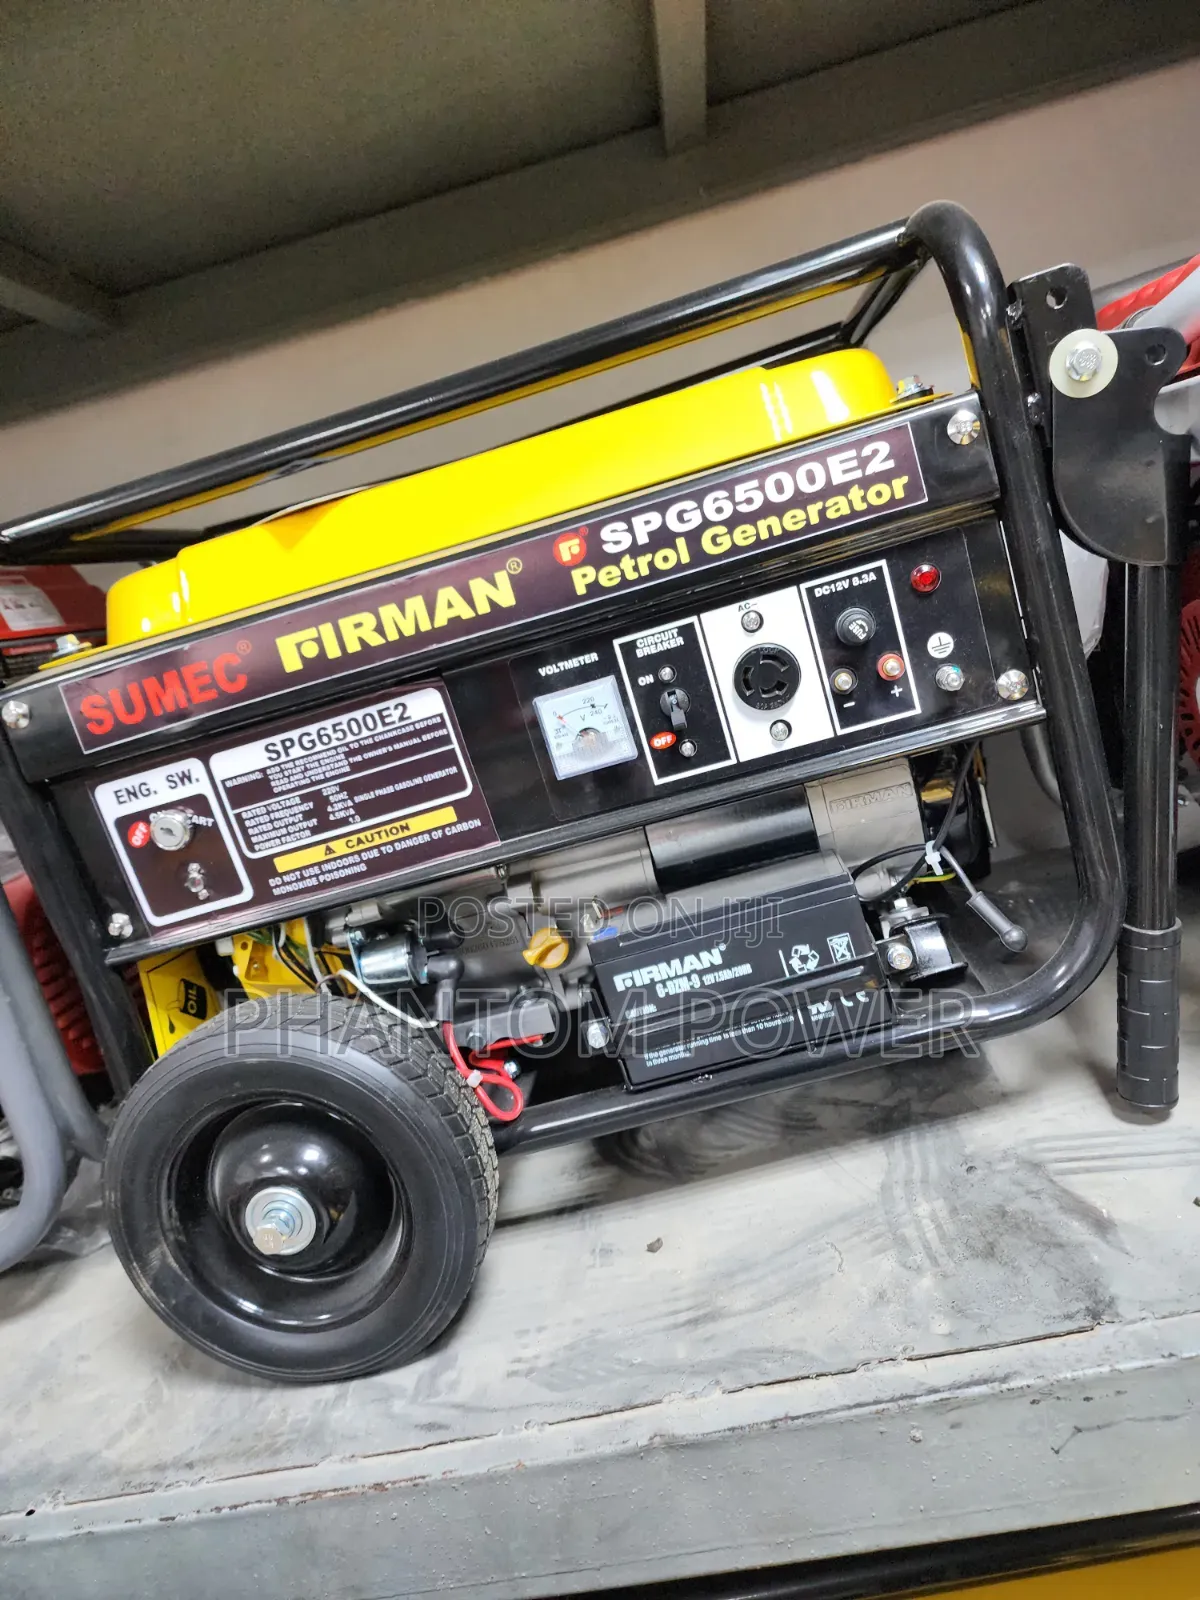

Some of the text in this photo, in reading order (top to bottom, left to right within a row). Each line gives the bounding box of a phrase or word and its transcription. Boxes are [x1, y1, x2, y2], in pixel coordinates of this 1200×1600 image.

[600, 440, 895, 554] SPG6500E2
[570, 475, 909, 596] Petrol Generator
[814, 571, 877, 598] DC12V 8.3A
[635, 636, 685, 658] BREAKER
[636, 627, 679, 648] CIRCUIT
[538, 652, 599, 677] VOLTMETER
[637, 673, 655, 687] ON
[582, 696, 595, 704] 220
[589, 708, 603, 716] 240
[580, 714, 586, 722] V
[264, 702, 412, 762] SPG6500E2
[653, 735, 673, 747] OFF
[224, 771, 264, 788] WARNING:
[266, 765, 281, 775] ADD
[280, 761, 295, 770] THE
[294, 749, 337, 767] RECOMMEND
[360, 738, 374, 747] THE
[414, 716, 442, 730] BEFORE
[270, 728, 448, 787] READ AND UNDERSTAND THE OWNER'S MANUAL BEFORE
[268, 753, 346, 780] YOU START THE ENGINE
[272, 766, 351, 794] OPERATING THE ENGINE
[113, 769, 200, 805] ENG. SW.
[353, 765, 458, 803] SINGLE PHASE GASOLINE GENERATOR
[241, 785, 340, 820] RATED VOLTAGE 220V
[828, 781, 914, 815] FIRMAN
[244, 814, 270, 828] RATED
[269, 801, 314, 820] FREQUENCY
[247, 799, 354, 836] RATED OUTPUT 4.2KVA
[250, 808, 356, 844] MAXIMUM OUTPUT 4.5KVA
[131, 821, 148, 846] OFF
[254, 815, 361, 851] POWER FACTOR 1.0
[345, 822, 411, 849] CAUTION
[268, 818, 482, 887] DO NOT USE INDOORS DUE TO DANGER OF CARBON
[272, 863, 368, 896] MONOXIDE POISONING
[186, 983, 198, 1015] OIL
[655, 973, 701, 998] 6-DZM-9
[708, 1034, 722, 1043] time
[741, 1026, 756, 1035] than
[763, 1019, 782, 1029] hours
[652, 1057, 668, 1066] three
